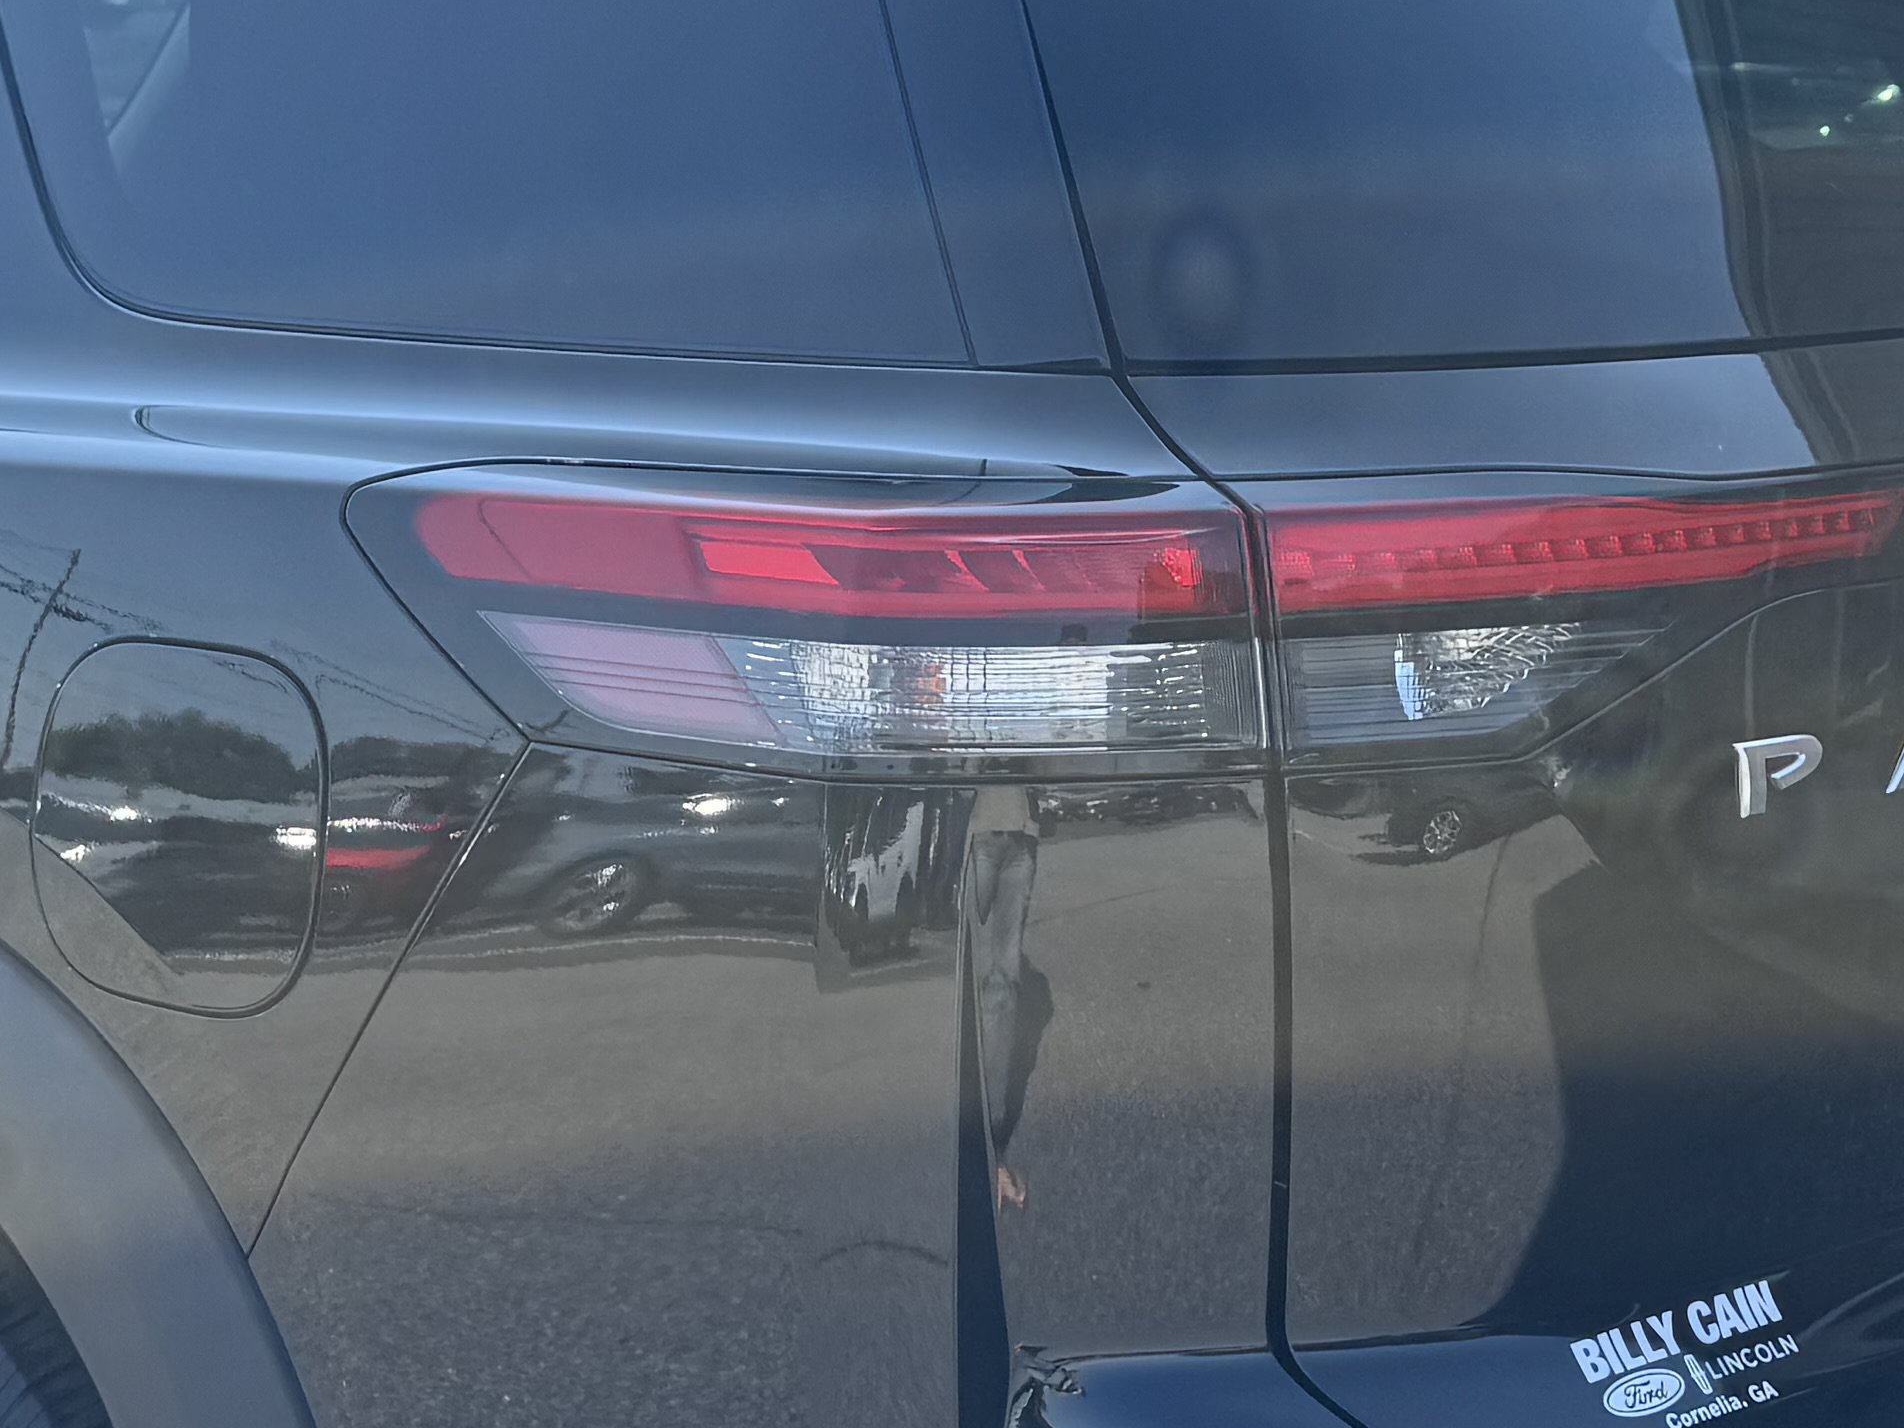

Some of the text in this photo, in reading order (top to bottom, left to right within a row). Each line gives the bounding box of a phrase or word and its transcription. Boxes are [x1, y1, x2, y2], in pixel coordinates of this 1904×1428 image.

[1570, 1280, 1783, 1384] BILLY CAIN
[1704, 1334, 1799, 1380] LINCOLN
[1624, 1379, 1668, 1409] Ford
[1748, 1380, 1779, 1403] GA
